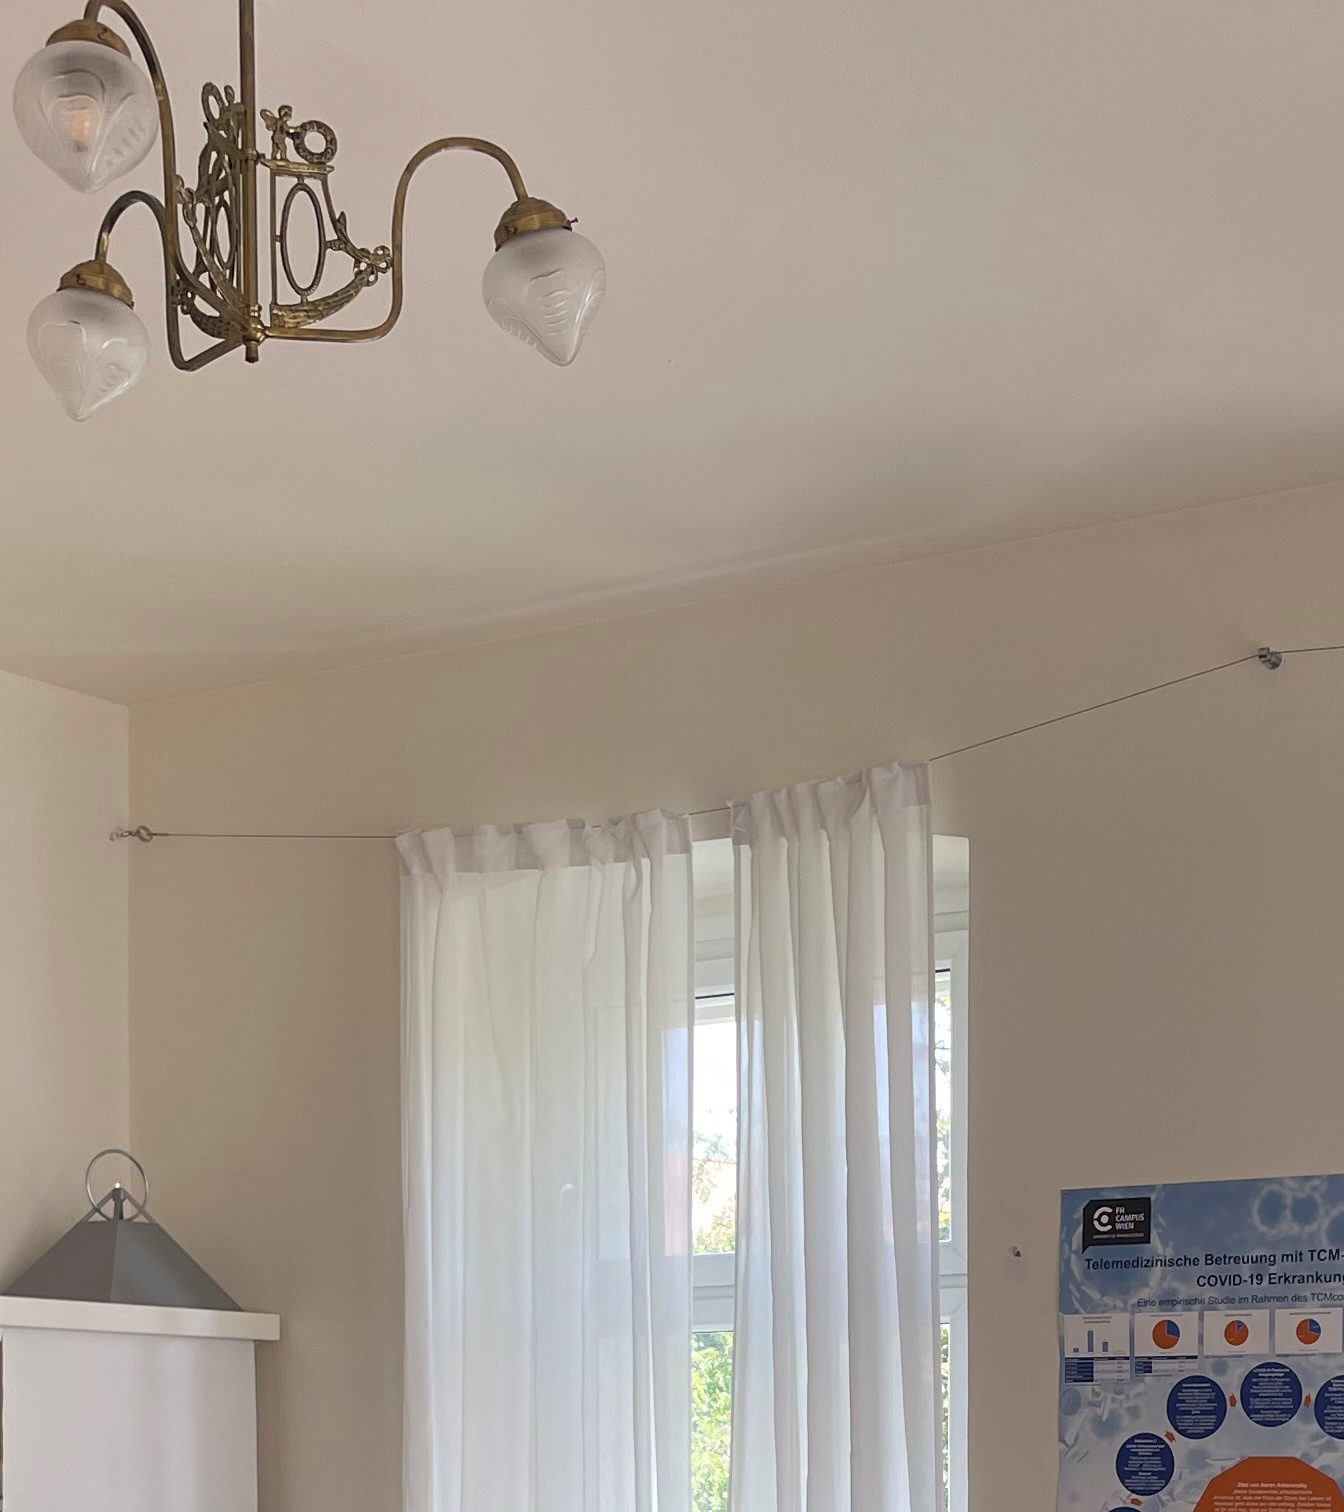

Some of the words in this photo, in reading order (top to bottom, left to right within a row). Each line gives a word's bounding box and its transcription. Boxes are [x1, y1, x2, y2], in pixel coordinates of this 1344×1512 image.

[1115, 1213, 1145, 1223] CAMPUS
[1085, 1254, 1200, 1271] Telemedizinische
[1205, 1253, 1277, 1268] Betreuung
[1281, 1251, 1304, 1263] mit
[1196, 1273, 1264, 1288] COVID-19
[1137, 1298, 1156, 1307] Eine
[1158, 1295, 1206, 1308] empirische
[1207, 1295, 1236, 1306] Studie
[1238, 1295, 1249, 1305] im
[1251, 1293, 1289, 1304] Rahmen
[1290, 1292, 1308, 1302] des
